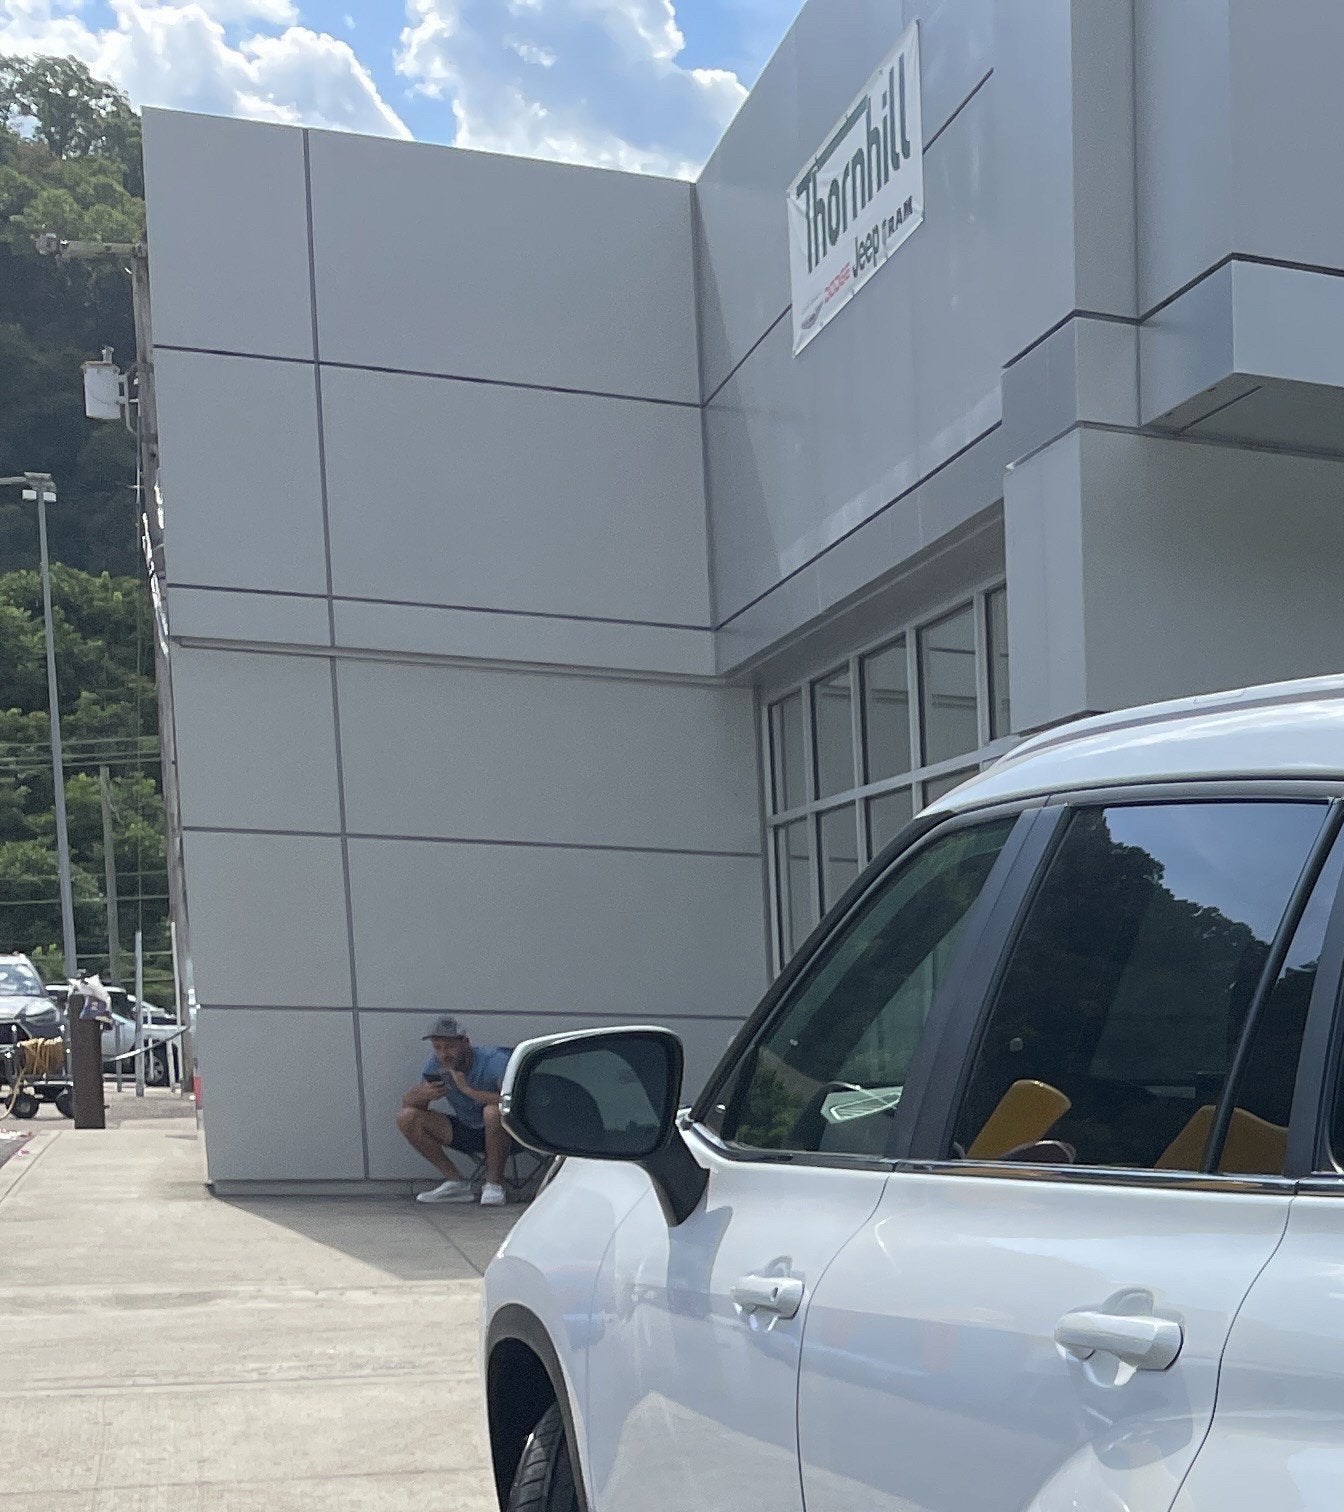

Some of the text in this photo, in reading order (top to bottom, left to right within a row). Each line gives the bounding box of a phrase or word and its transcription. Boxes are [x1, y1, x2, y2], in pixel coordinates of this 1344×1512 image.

[796, 53, 911, 275] Thornhill
[852, 195, 913, 278] Jeep RAM
